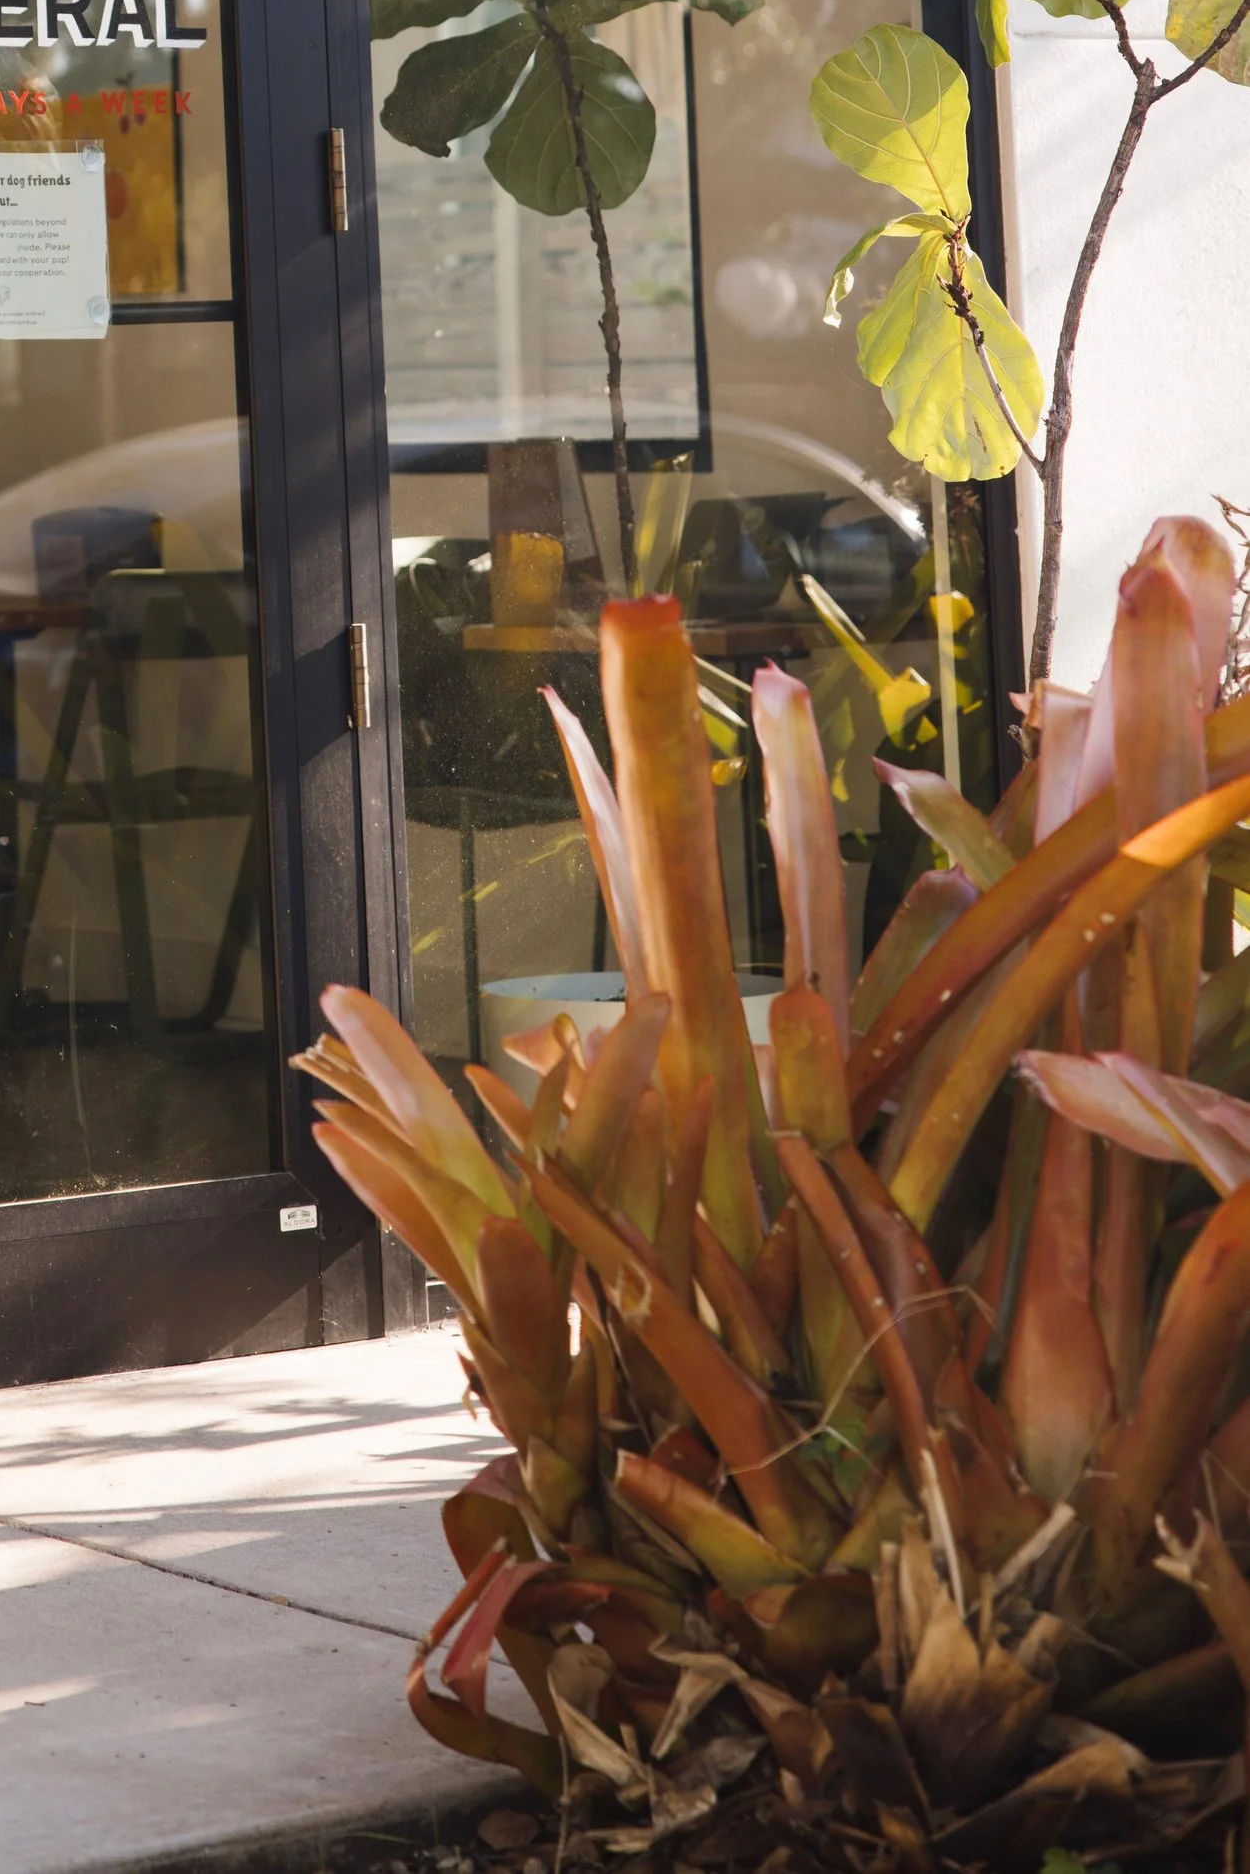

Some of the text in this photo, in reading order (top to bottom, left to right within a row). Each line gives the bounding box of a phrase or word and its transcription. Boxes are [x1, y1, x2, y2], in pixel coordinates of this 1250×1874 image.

[65, 91, 83, 115] A
[101, 90, 193, 115] WEEK
[7, 175, 25, 188] dog
[28, 174, 71, 186] friends
[35, 218, 67, 227] beyond
[18, 231, 35, 239] only
[37, 230, 59, 238] allow
[45, 243, 70, 251] Please
[11, 256, 29, 264] with
[30, 257, 49, 265] your
[14, 269, 66, 278] cooperation.
